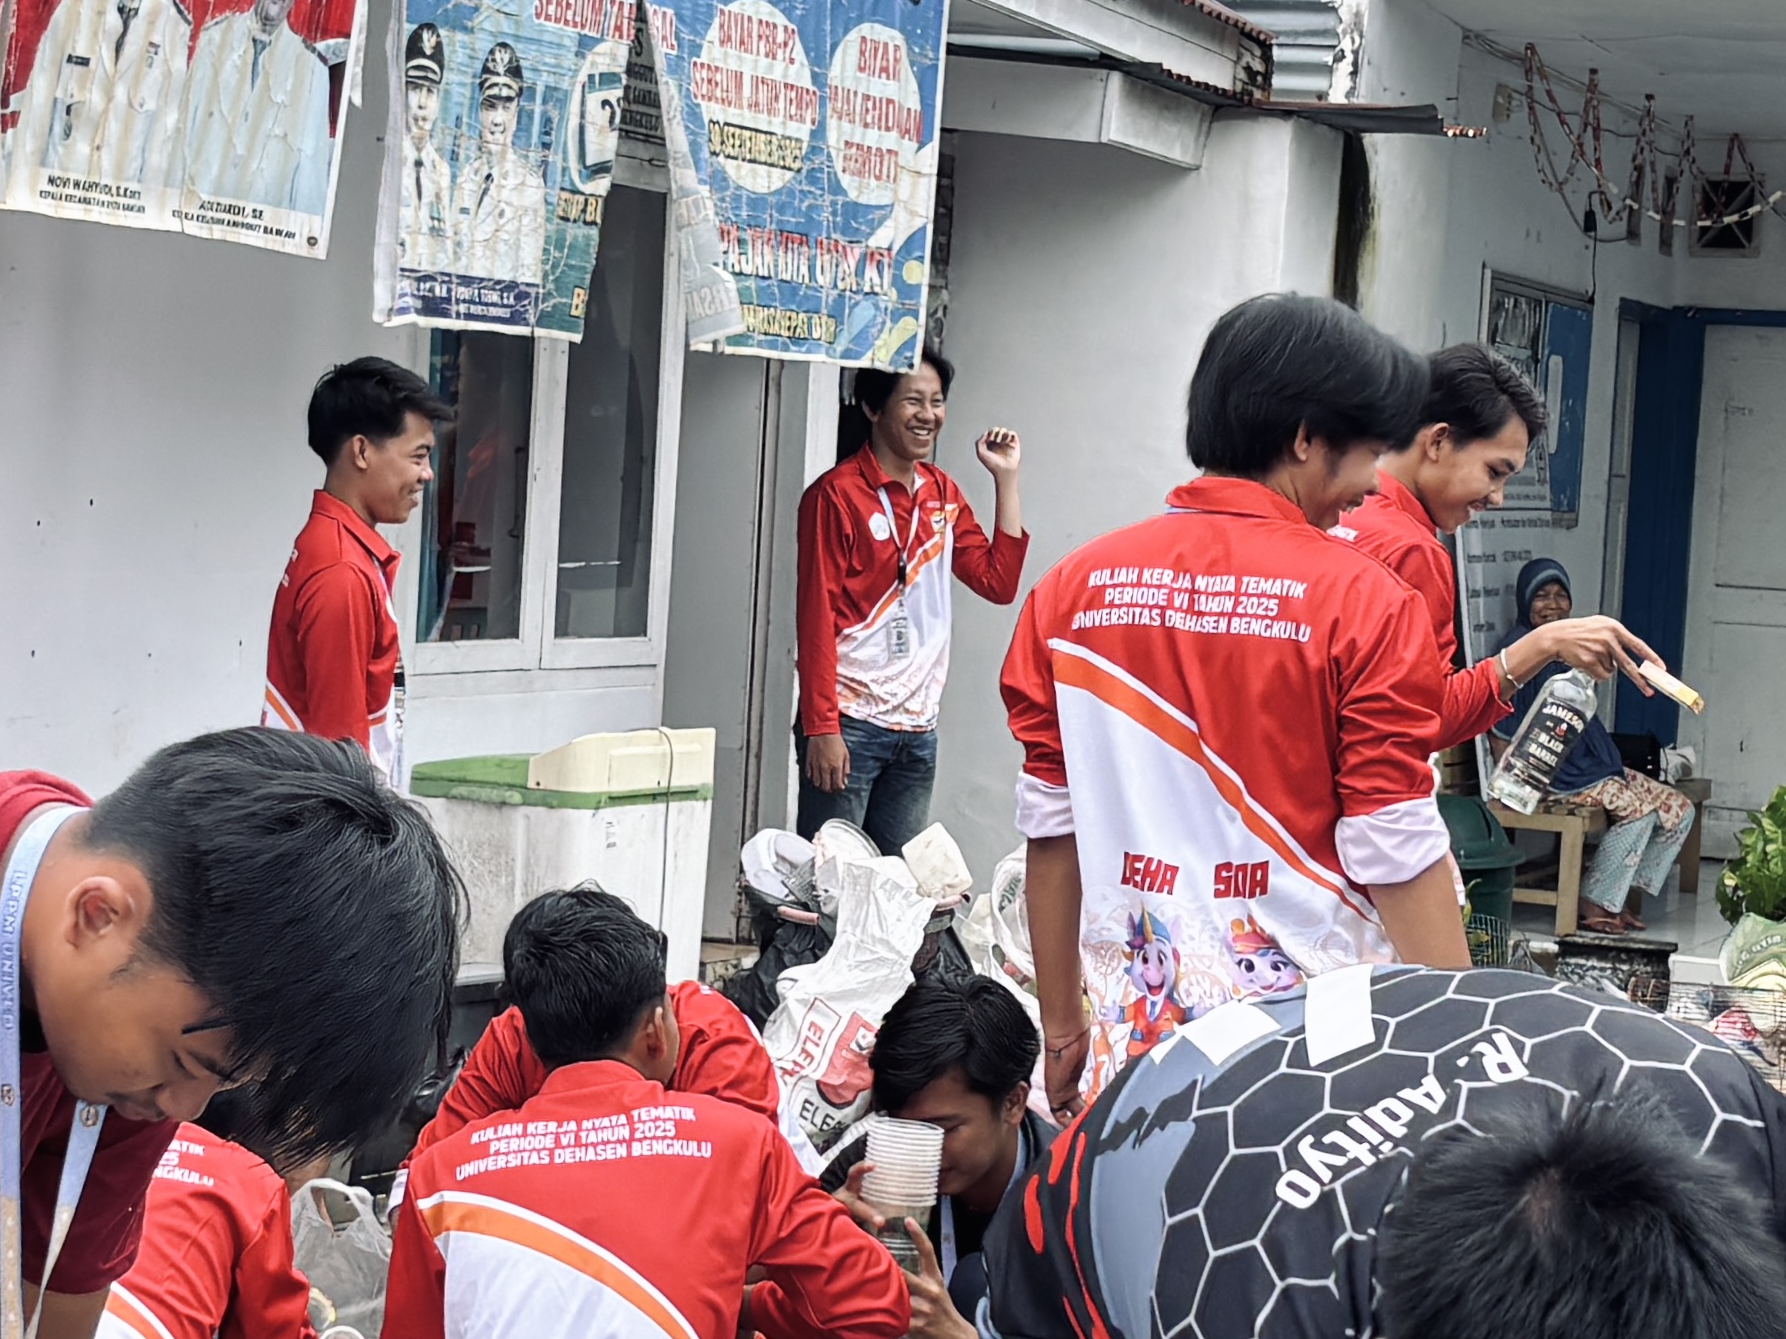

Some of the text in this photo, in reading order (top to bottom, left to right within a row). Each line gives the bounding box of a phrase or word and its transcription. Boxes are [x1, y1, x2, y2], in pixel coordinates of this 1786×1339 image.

[718, 8, 753, 52] BAYAR
[692, 61, 744, 109] SEBELUM
[1088, 567, 1307, 599] KULIAH KERJA NYATA TEMATIK
[1105, 587, 1279, 617] PERIODE VI TAHUN 2025
[1071, 607, 1312, 643] UNIVERSITAS DEHASEN BENGKULU
[470, 1106, 696, 1145] KULIAH KERJA NYATA TEMATIK
[489, 1121, 676, 1156] PERIODE VI TAHUN 2025
[1275, 1032, 1530, 1209] R. Adityo
[167, 1140, 205, 1156] ATIK
[455, 1140, 712, 1182] UNIVERSITAS DEHASEN BENGKULU
